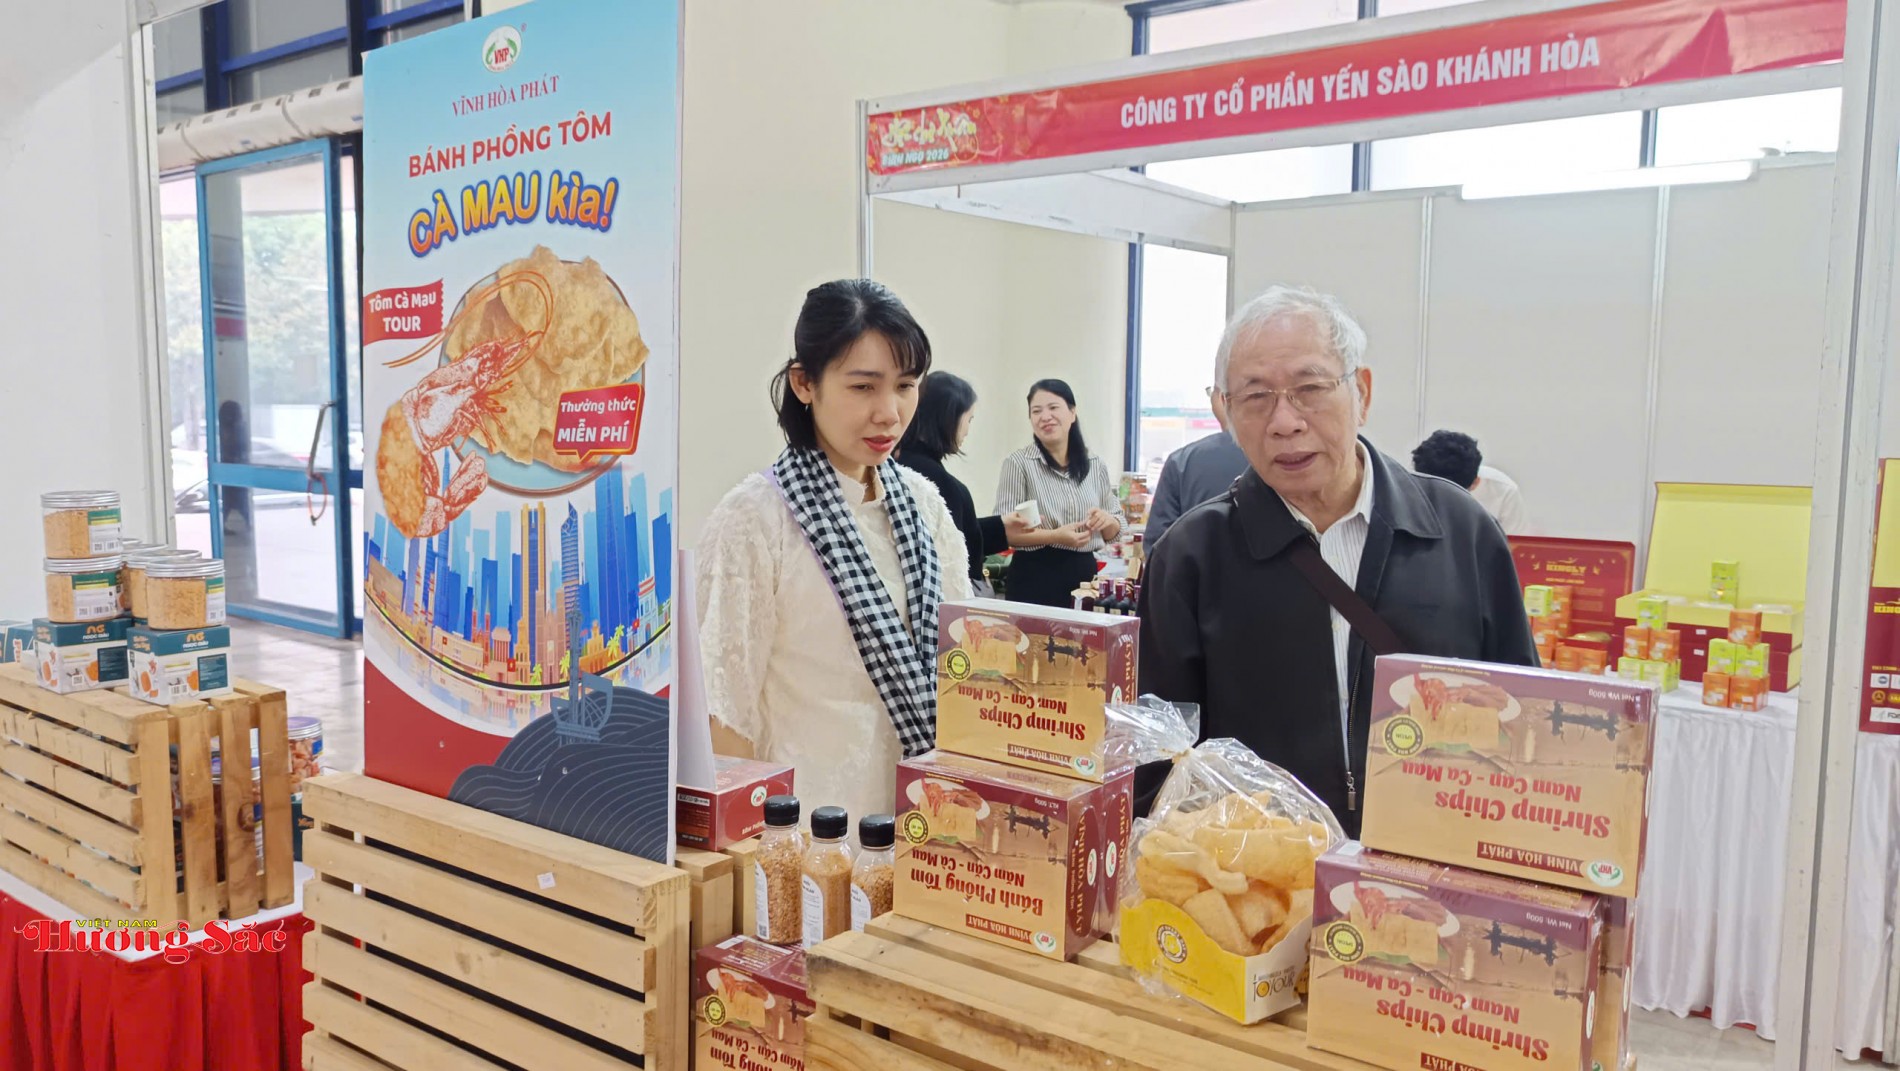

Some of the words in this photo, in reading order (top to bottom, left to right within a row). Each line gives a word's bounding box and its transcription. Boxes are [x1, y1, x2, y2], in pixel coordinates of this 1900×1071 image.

[1121, 95, 1177, 129] CÔNG
[1183, 92, 1208, 119] TY
[1214, 78, 1244, 116] CỔ
[1250, 72, 1314, 113] PHẦN
[1321, 63, 1369, 103] YẾN
[1376, 57, 1428, 95] SÀO
[1436, 48, 1530, 88] KHÁNH
[1540, 33, 1600, 70] HÒA
[452, 95, 484, 117] VĨNH
[487, 85, 517, 109] HÒA
[520, 73, 560, 101] PHÁT
[409, 144, 466, 178] BÁNH
[472, 123, 551, 165] PHỒNG
[558, 110, 611, 146] TÔM
[926, 148, 949, 162] 2026
[409, 189, 457, 257] CÀ
[461, 170, 541, 235] MAU
[548, 170, 618, 232] kìa!
[369, 295, 393, 313] Tôm
[394, 292, 409, 309] Cà
[383, 316, 421, 332] TOUR
[560, 400, 605, 416] Thưởng
[608, 397, 636, 412] thức
[557, 418, 597, 442] MIỄN
[600, 420, 630, 442] PHÍ
[958, 684, 981, 701] Mau
[986, 690, 1001, 704] Ca
[1011, 695, 1034, 709] Can
[979, 706, 1022, 730] Chips
[1026, 714, 1086, 741] Shrimp
[1402, 761, 1443, 783] Mau
[1447, 767, 1472, 786] Ca
[1489, 774, 1528, 794] Can
[1532, 779, 1582, 803] Nam
[1435, 790, 1506, 821] Chips
[1511, 800, 1611, 839] Shrimp
[912, 850, 938, 866] Mau
[1481, 843, 1513, 860] PHÁT
[1517, 850, 1543, 865] HÒA
[941, 857, 956, 871] Cà
[966, 862, 991, 879] Căn
[1550, 857, 1580, 872] VĨNH
[911, 868, 942, 892] Tôm
[994, 870, 1025, 888] Năm
[946, 875, 997, 905] Phồng
[1000, 891, 1043, 917] Bánh
[1558, 920, 1572, 930] Net
[1343, 966, 1384, 991] Mau
[1387, 979, 1411, 997] Ca
[1376, 999, 1446, 1035] Chips
[1470, 1000, 1520, 1024] Nam
[711, 1029, 734, 1046] Mau
[736, 1037, 749, 1053] Cà
[1451, 1014, 1550, 1061] Shrimp
[710, 1047, 735, 1070] Tôm
[757, 1046, 778, 1063] Căn
